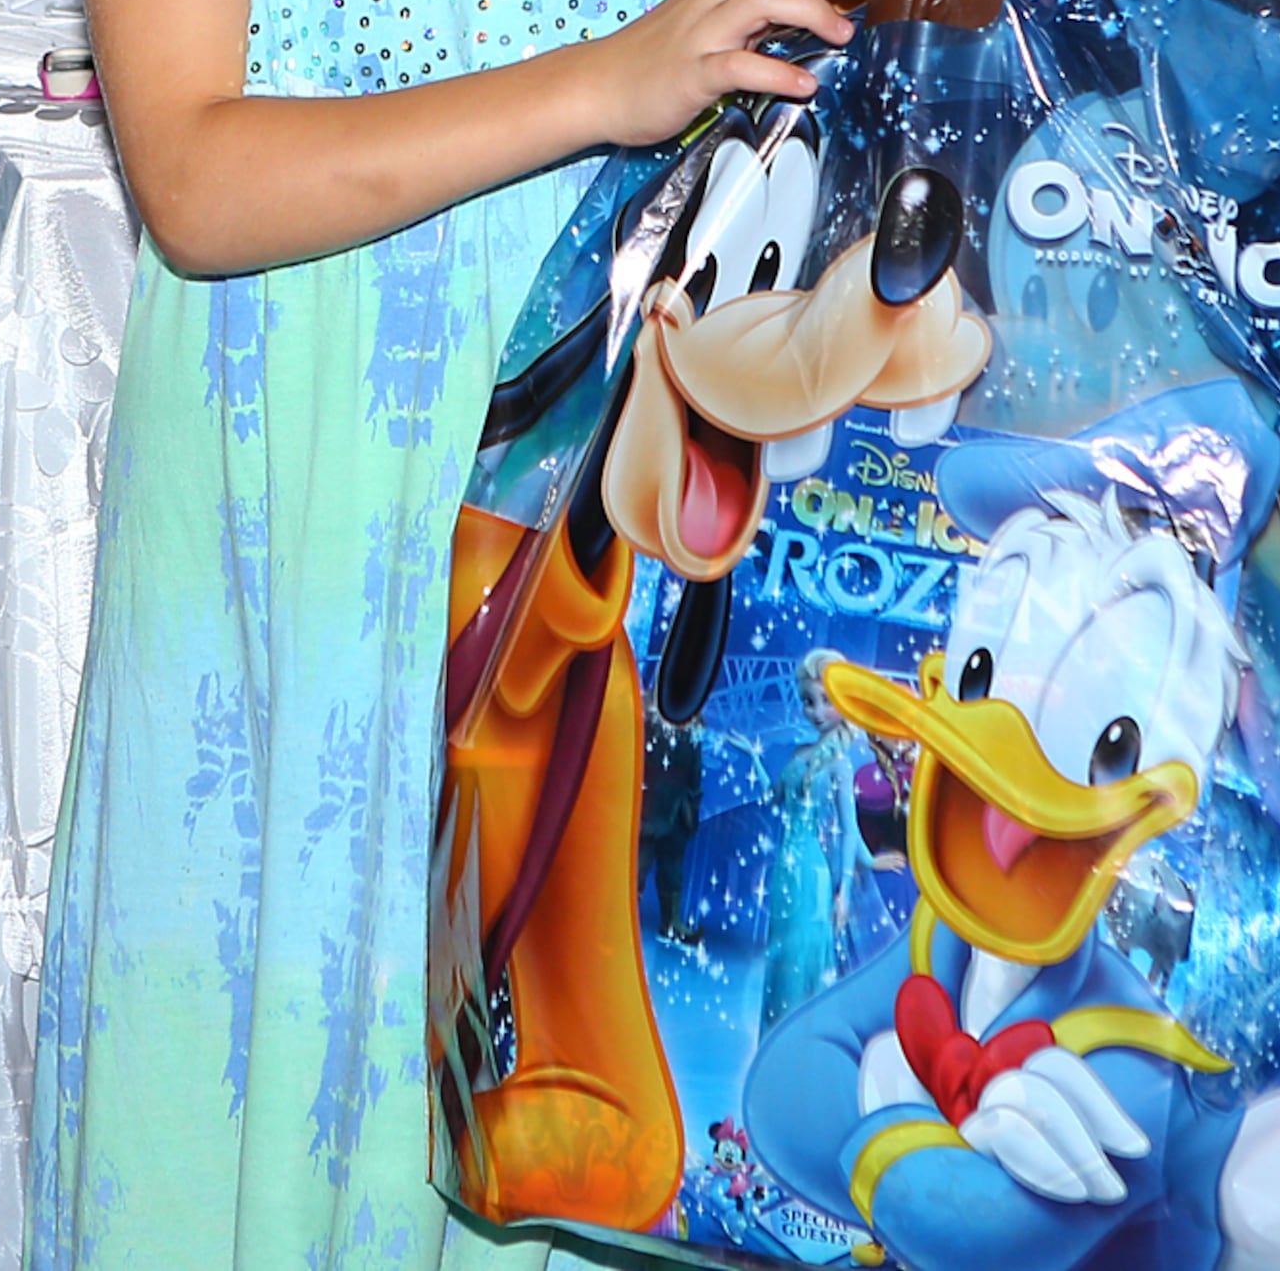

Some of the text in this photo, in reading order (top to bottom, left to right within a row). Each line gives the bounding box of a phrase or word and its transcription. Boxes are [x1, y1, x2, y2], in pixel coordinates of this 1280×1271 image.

[1006, 159, 1155, 258] ON
[790, 478, 874, 538] ON
[781, 1222, 848, 1247] GUESTS
